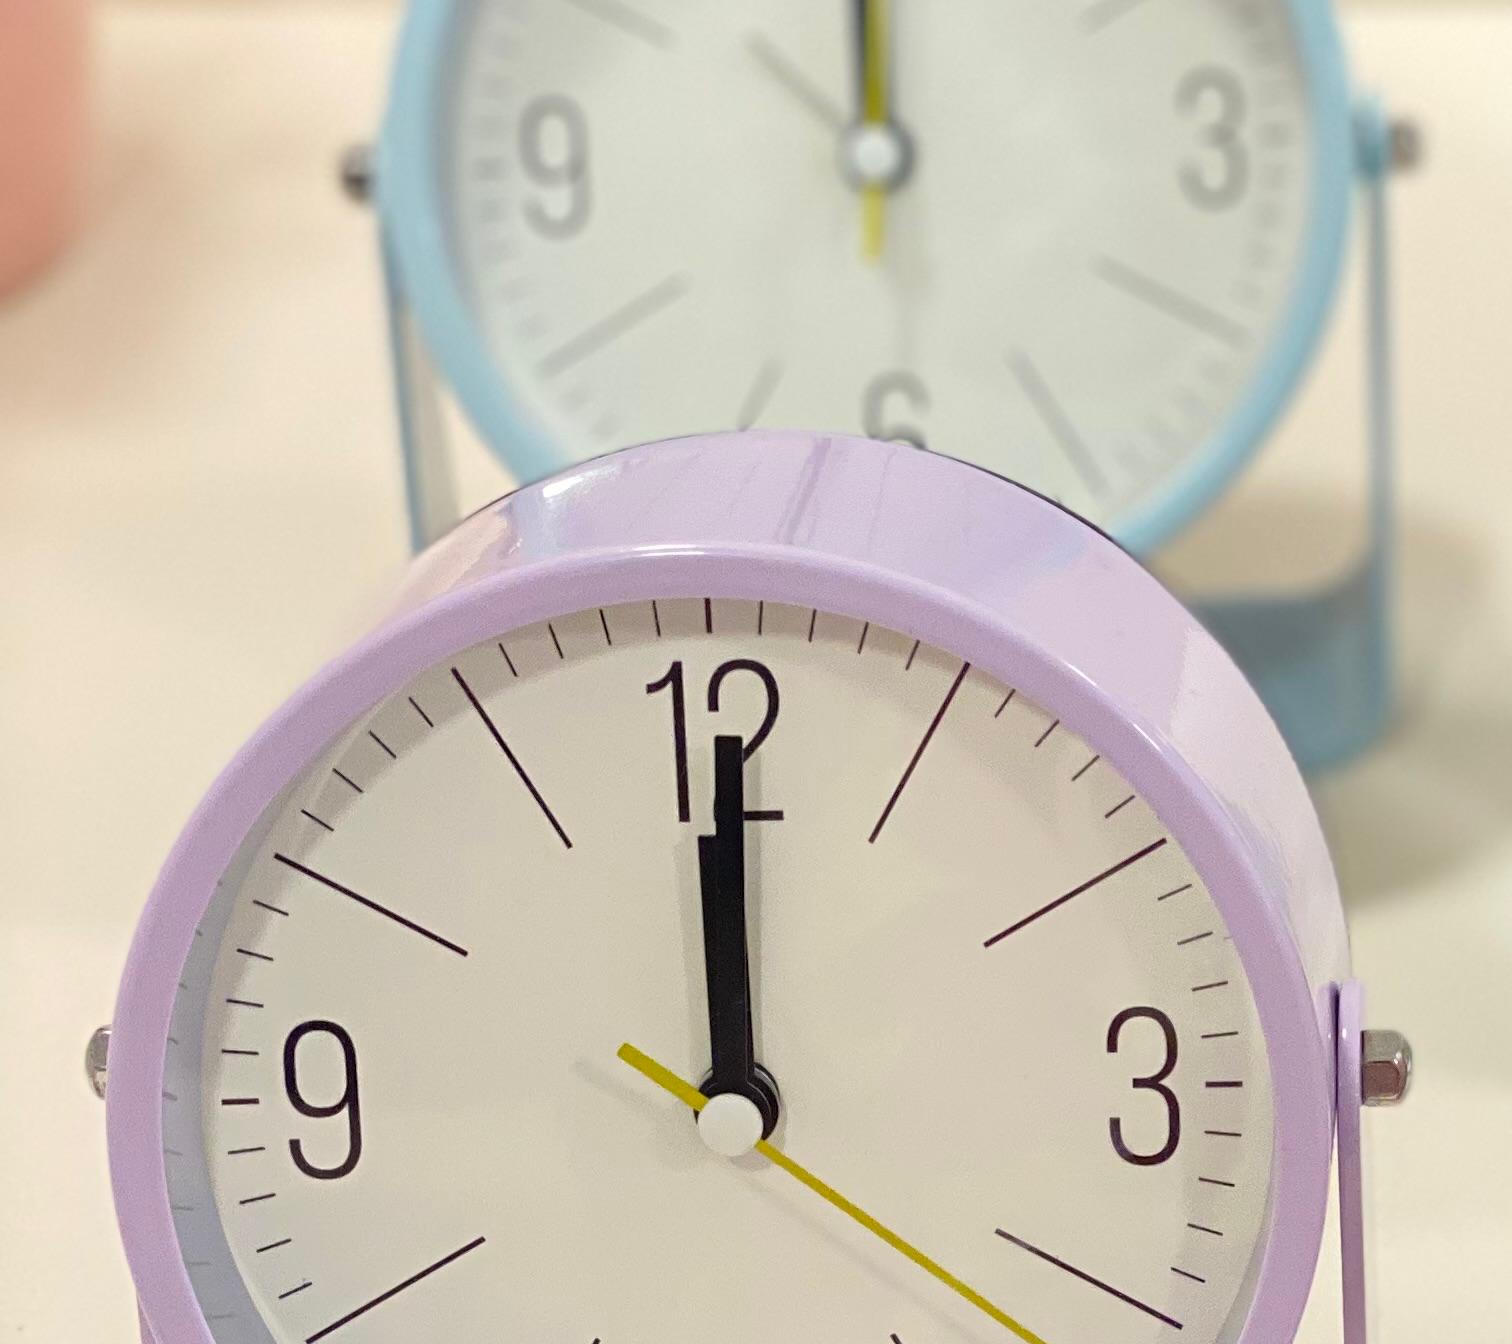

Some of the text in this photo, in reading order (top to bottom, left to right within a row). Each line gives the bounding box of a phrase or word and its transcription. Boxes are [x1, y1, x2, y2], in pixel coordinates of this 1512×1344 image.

[516, 92, 592, 241] 9
[1173, 65, 1250, 212] 3
[645, 657, 785, 824] 12
[281, 1018, 363, 1180] 9
[1104, 1005, 1181, 1167] 3
